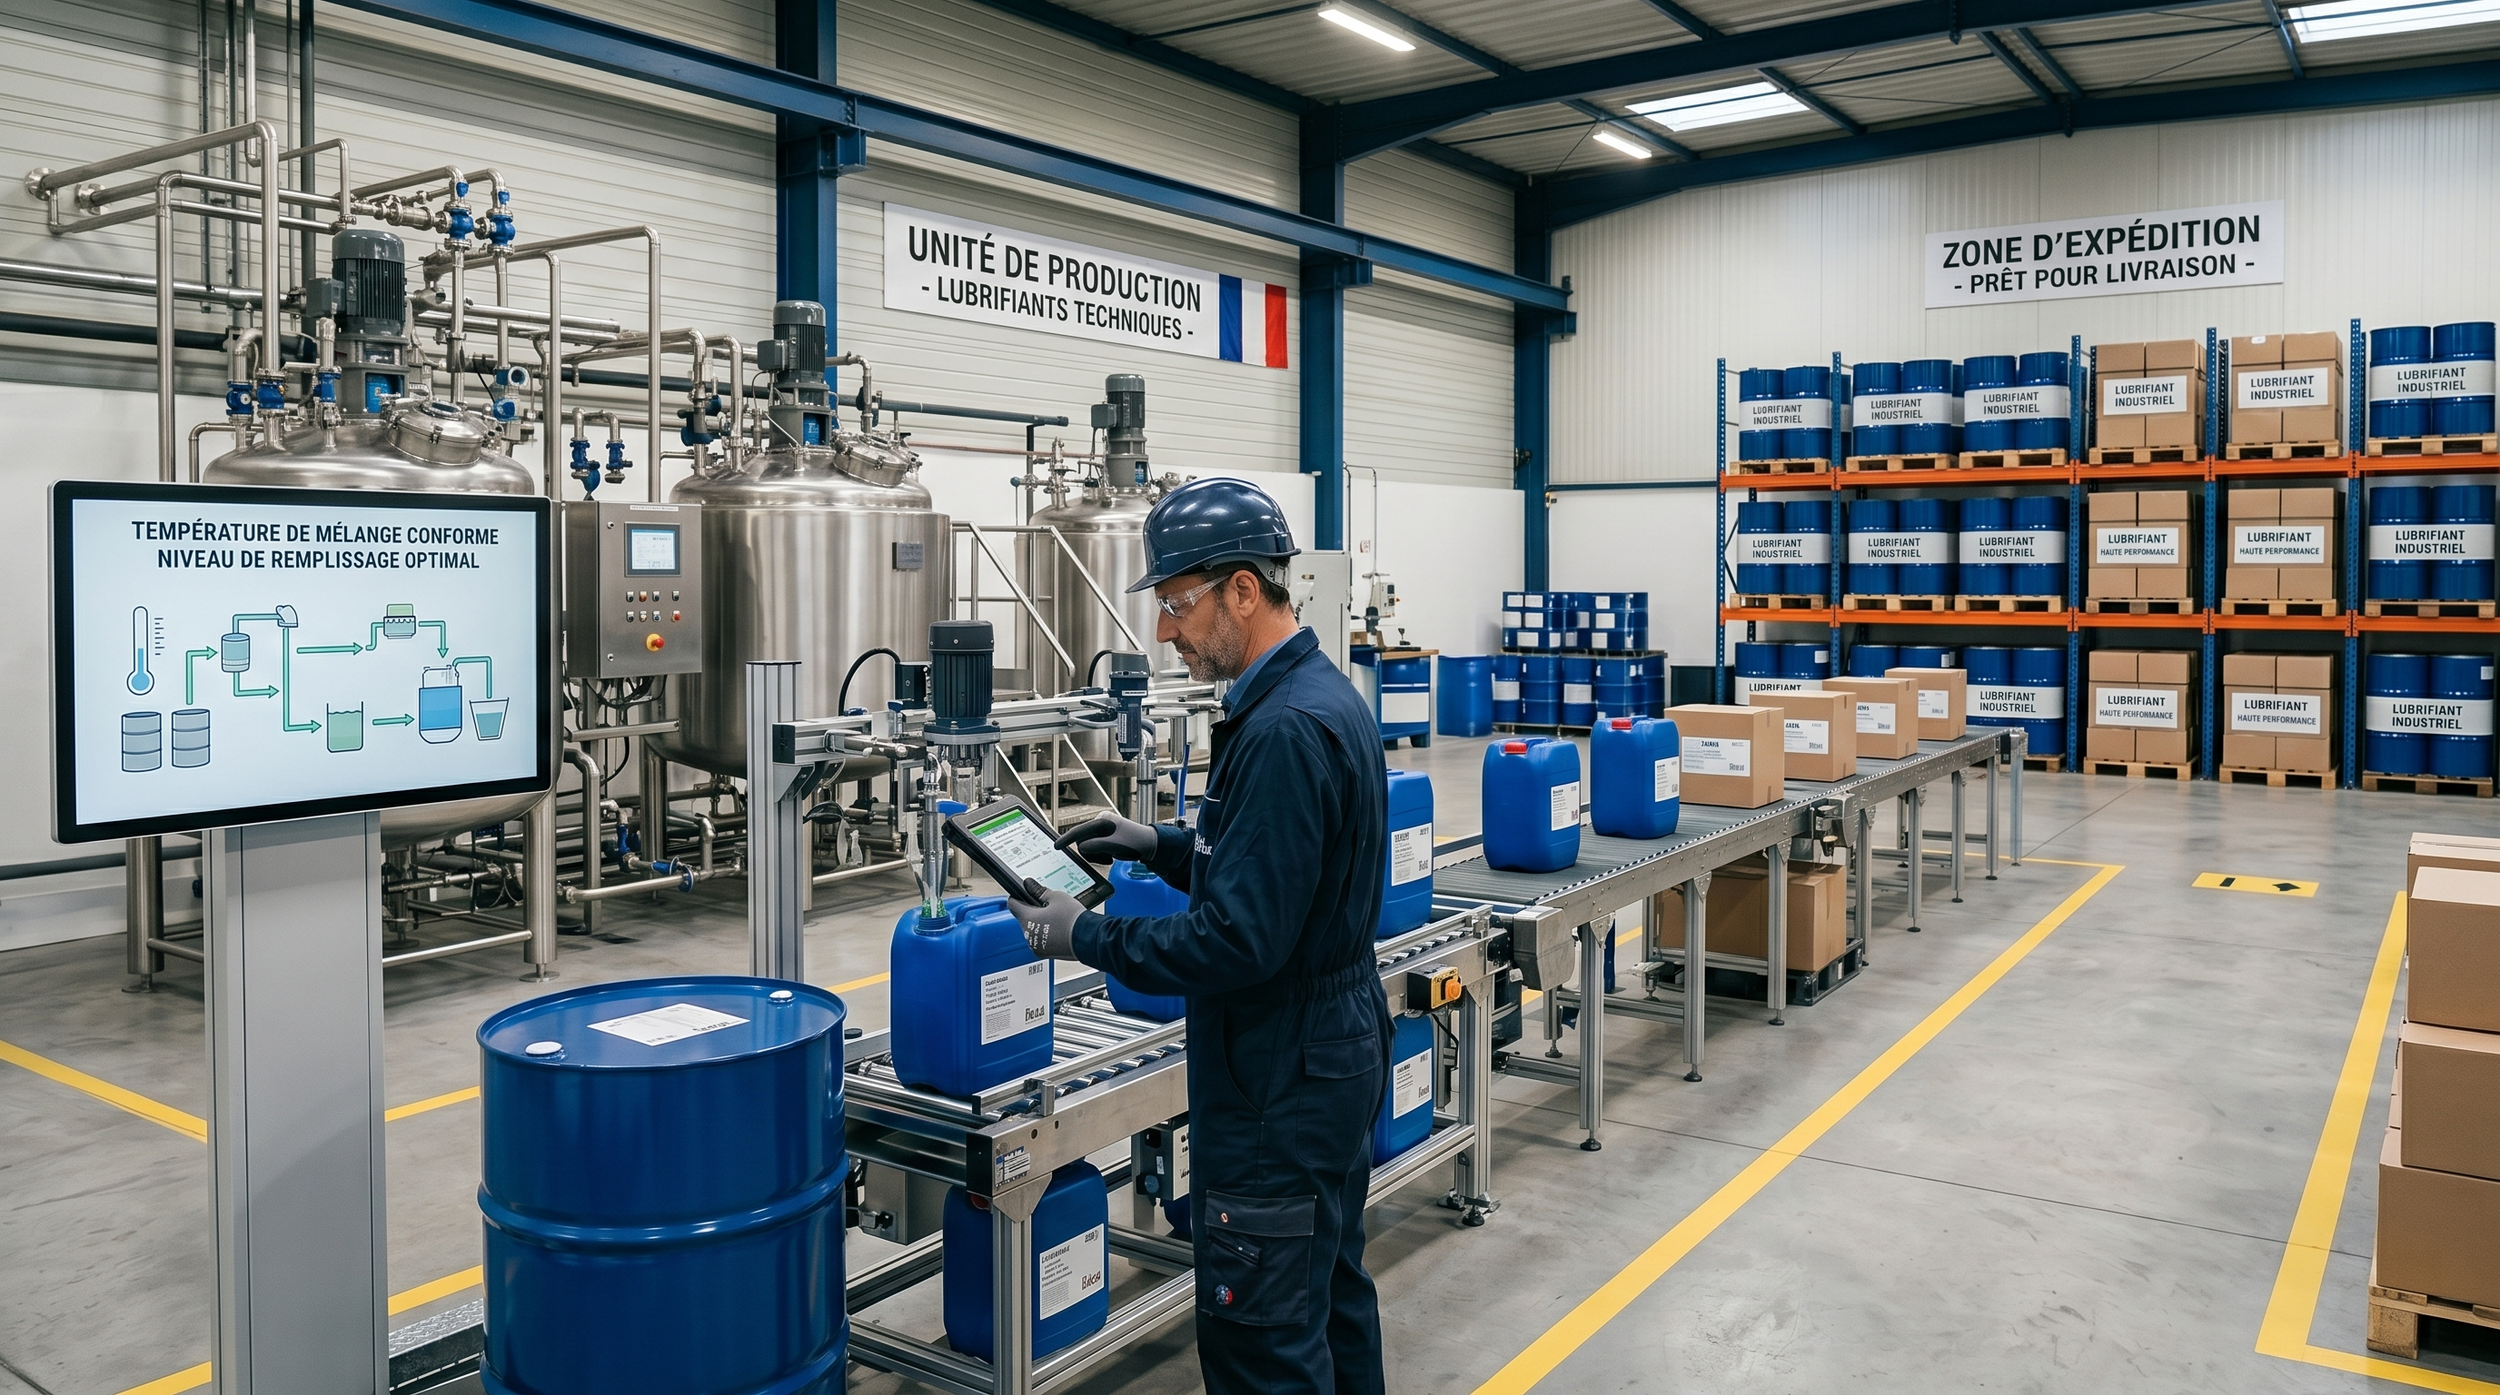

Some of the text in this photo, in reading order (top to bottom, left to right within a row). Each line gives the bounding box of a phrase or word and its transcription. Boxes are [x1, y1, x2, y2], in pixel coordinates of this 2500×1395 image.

[1942, 235, 2023, 269] ZONE
[909, 225, 1201, 313] UNITÉ DE PRODUCTION
[1970, 267, 2028, 294] PRÊT
[2035, 265, 2098, 290] POUR
[2106, 253, 2236, 284] LIVRAISON
[937, 275, 1069, 322] LUBRIFIANTS
[1073, 300, 1182, 341] TECHNIQUES
[2397, 366, 2467, 381] LUBRIFIANT
[2250, 375, 2315, 388] LUBRIFIANT
[2398, 380, 2467, 394] INDUSTRIEL
[2115, 382, 2175, 395] LUBRIFIANT
[2250, 388, 2315, 401] INDUSTRIEL
[1983, 391, 2040, 404] LUBRIFIANT
[2115, 395, 2175, 407] INDUSTRIEL
[1870, 398, 1922, 410] LUBRIFIANT
[131, 517, 499, 545] TEMPÉRATURE DE MÉLANGE CONFORME
[2395, 529, 2466, 541] LUBRIFIANT
[1752, 538, 1803, 549] LUBRIFIANT
[1867, 537, 1921, 547] LUBRIFIANT
[1979, 536, 2035, 547] LUBRIFIANT
[2108, 533, 2168, 544] LUBRIFIANT
[2247, 532, 2312, 543] LUBRIFIANT
[2100, 548, 2123, 556] HAUTE
[2239, 547, 2264, 555] HAUTE
[2395, 543, 2466, 554] INDUSTRIEL
[157, 549, 480, 569] NIVEAU DE REMPLISSAGE OPTIMAL
[1980, 690, 2036, 702] LUBRIFIANT
[2107, 695, 2166, 707] LUBRIFIANT
[2244, 699, 2308, 712] LUBRIFIANT
[2392, 703, 2463, 716] LUBRIFIANT
[2099, 709, 2121, 718] HAUTE
[2237, 714, 2261, 723] HAUTE
[2392, 716, 2463, 730] INDUSTRIEL
